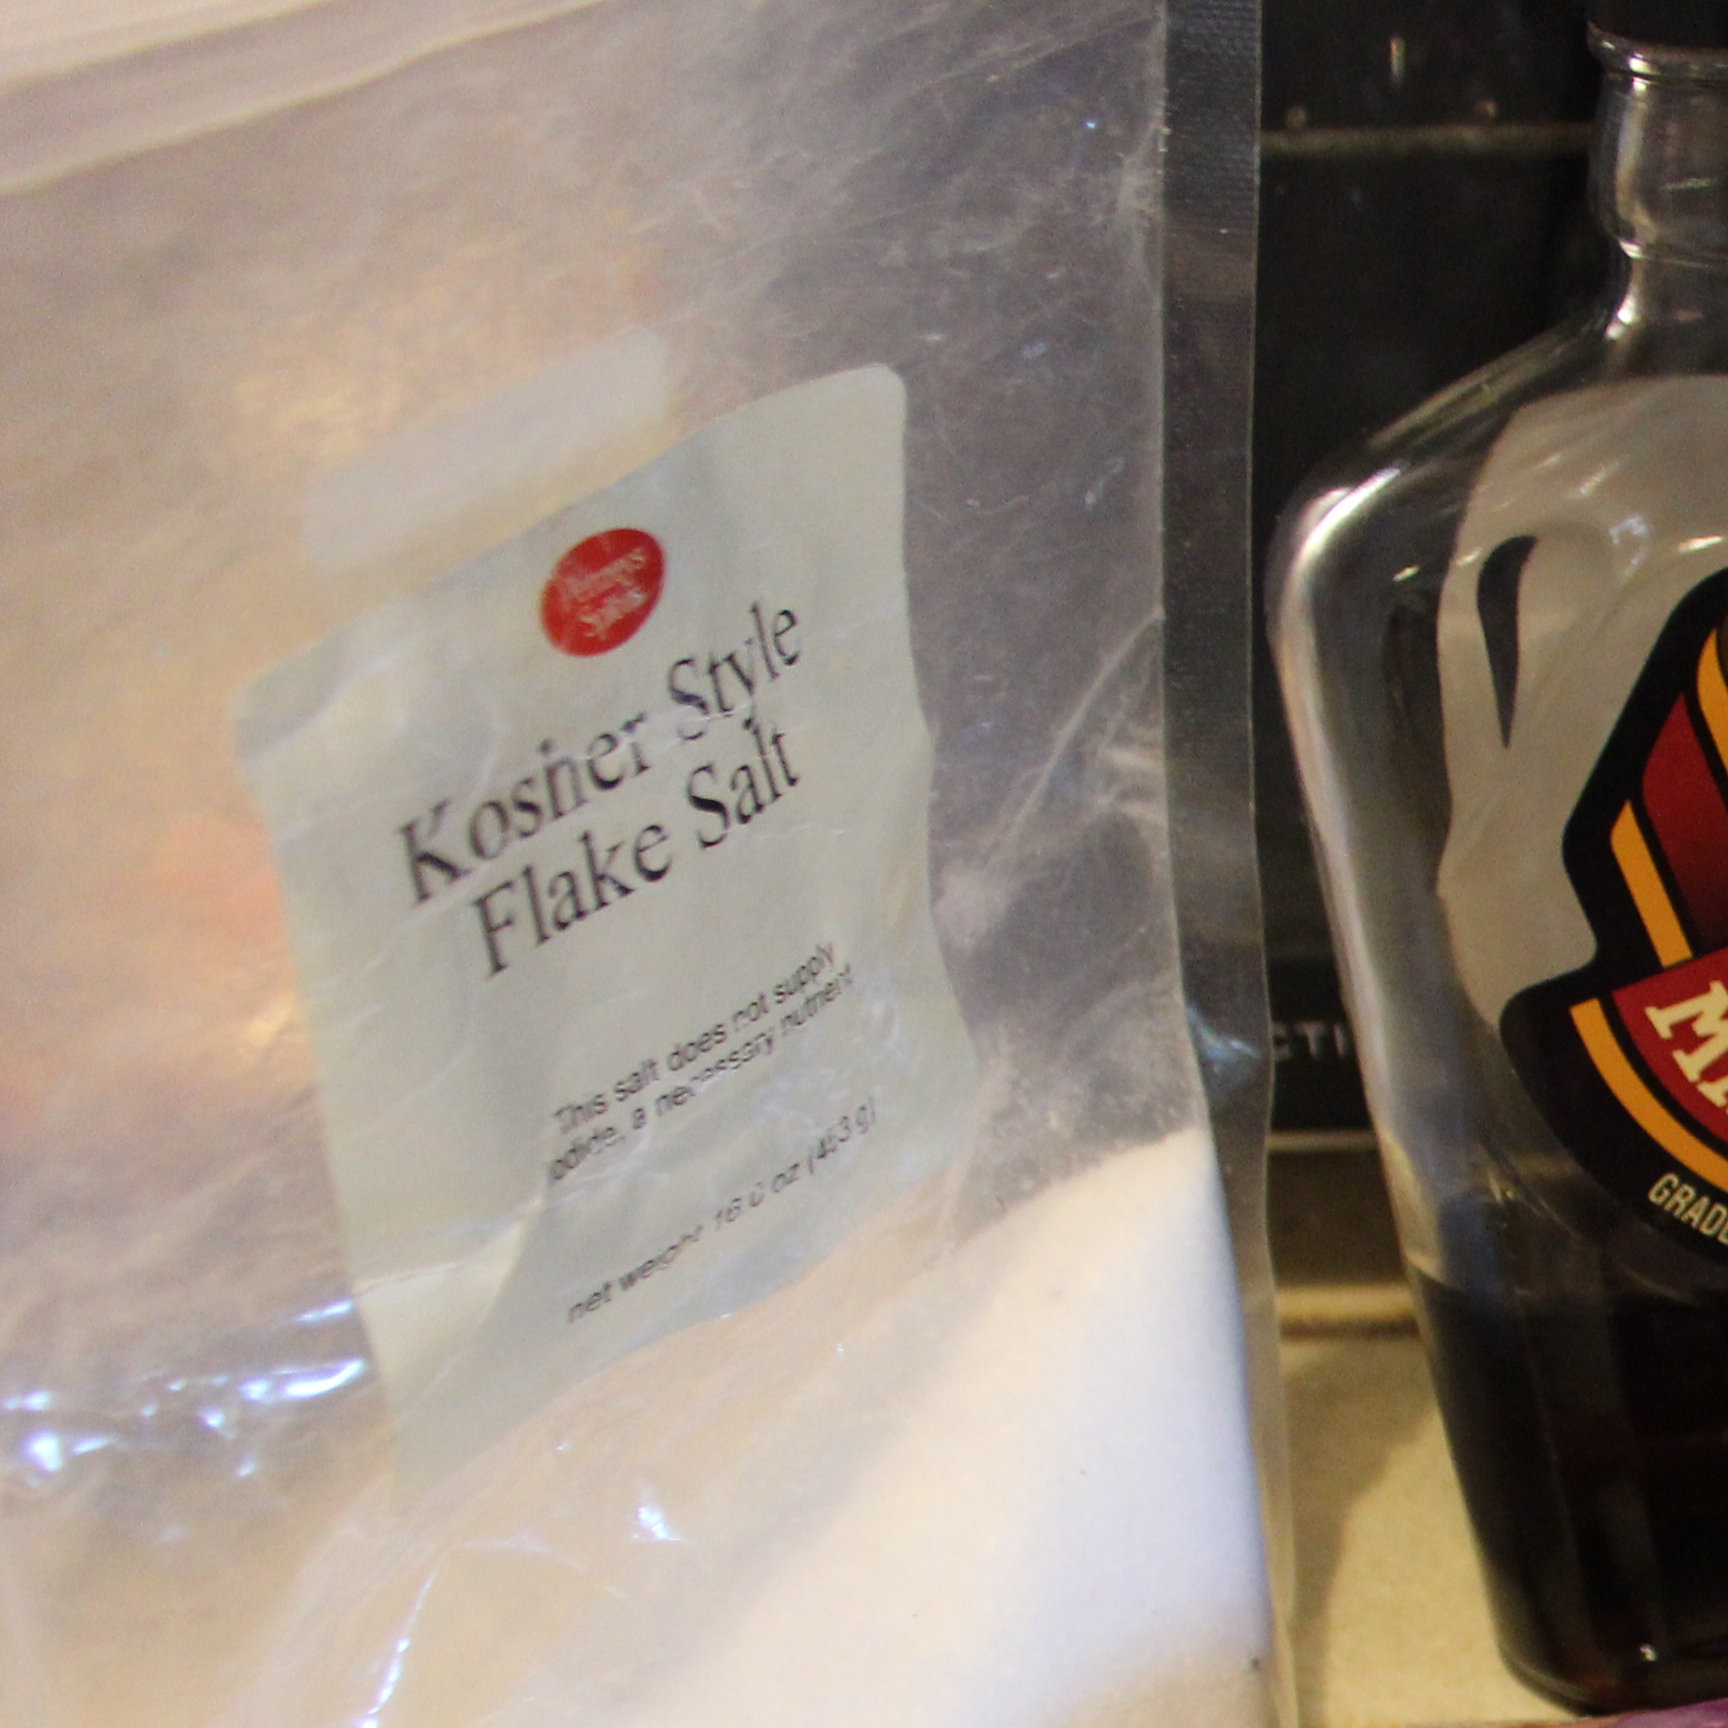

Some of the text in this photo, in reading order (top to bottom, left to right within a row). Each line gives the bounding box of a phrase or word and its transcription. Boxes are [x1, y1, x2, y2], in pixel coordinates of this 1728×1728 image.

[396, 601, 801, 905] Kosher Style
[471, 716, 800, 979] Flake Salt
[553, 942, 834, 1134] This salt does not supply
[632, 1108, 647, 1131] a
[569, 1281, 612, 1323] net
[772, 1163, 800, 1193] oz
